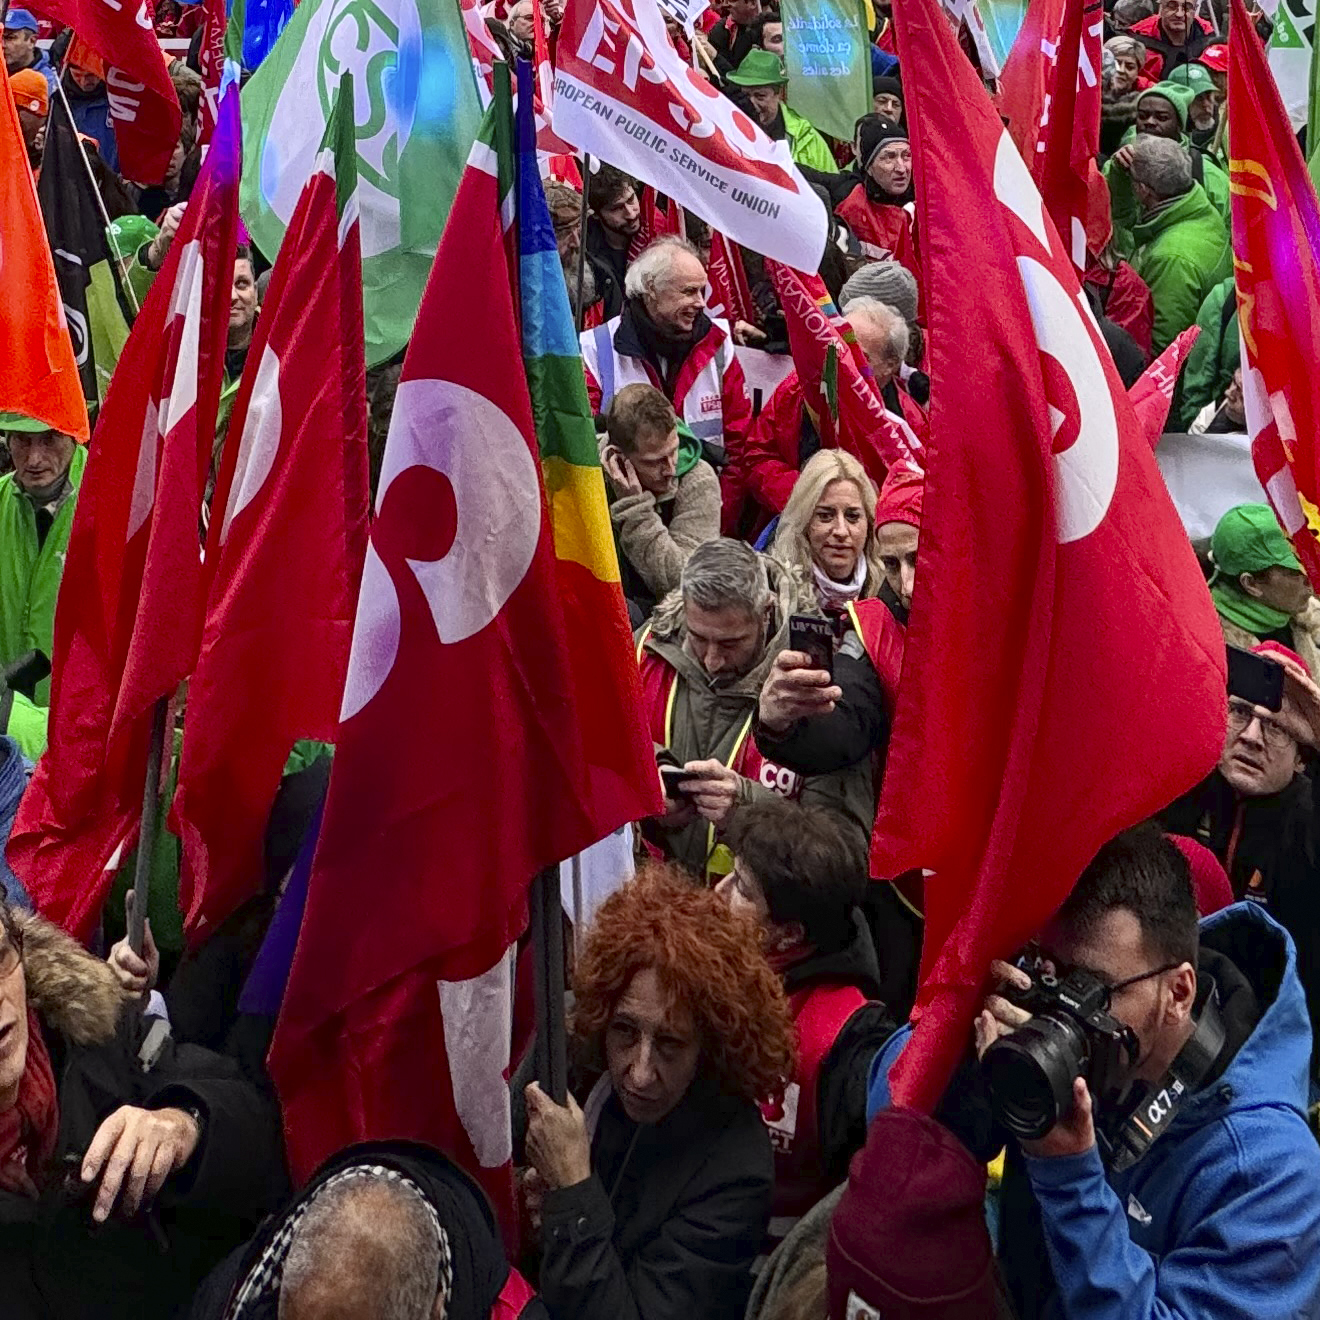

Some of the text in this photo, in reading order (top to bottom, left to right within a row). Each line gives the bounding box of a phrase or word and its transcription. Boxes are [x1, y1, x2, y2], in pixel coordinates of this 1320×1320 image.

[614, 114, 668, 155] PUBLIC
[669, 148, 729, 194] SERVICE
[730, 188, 781, 220] UNION
